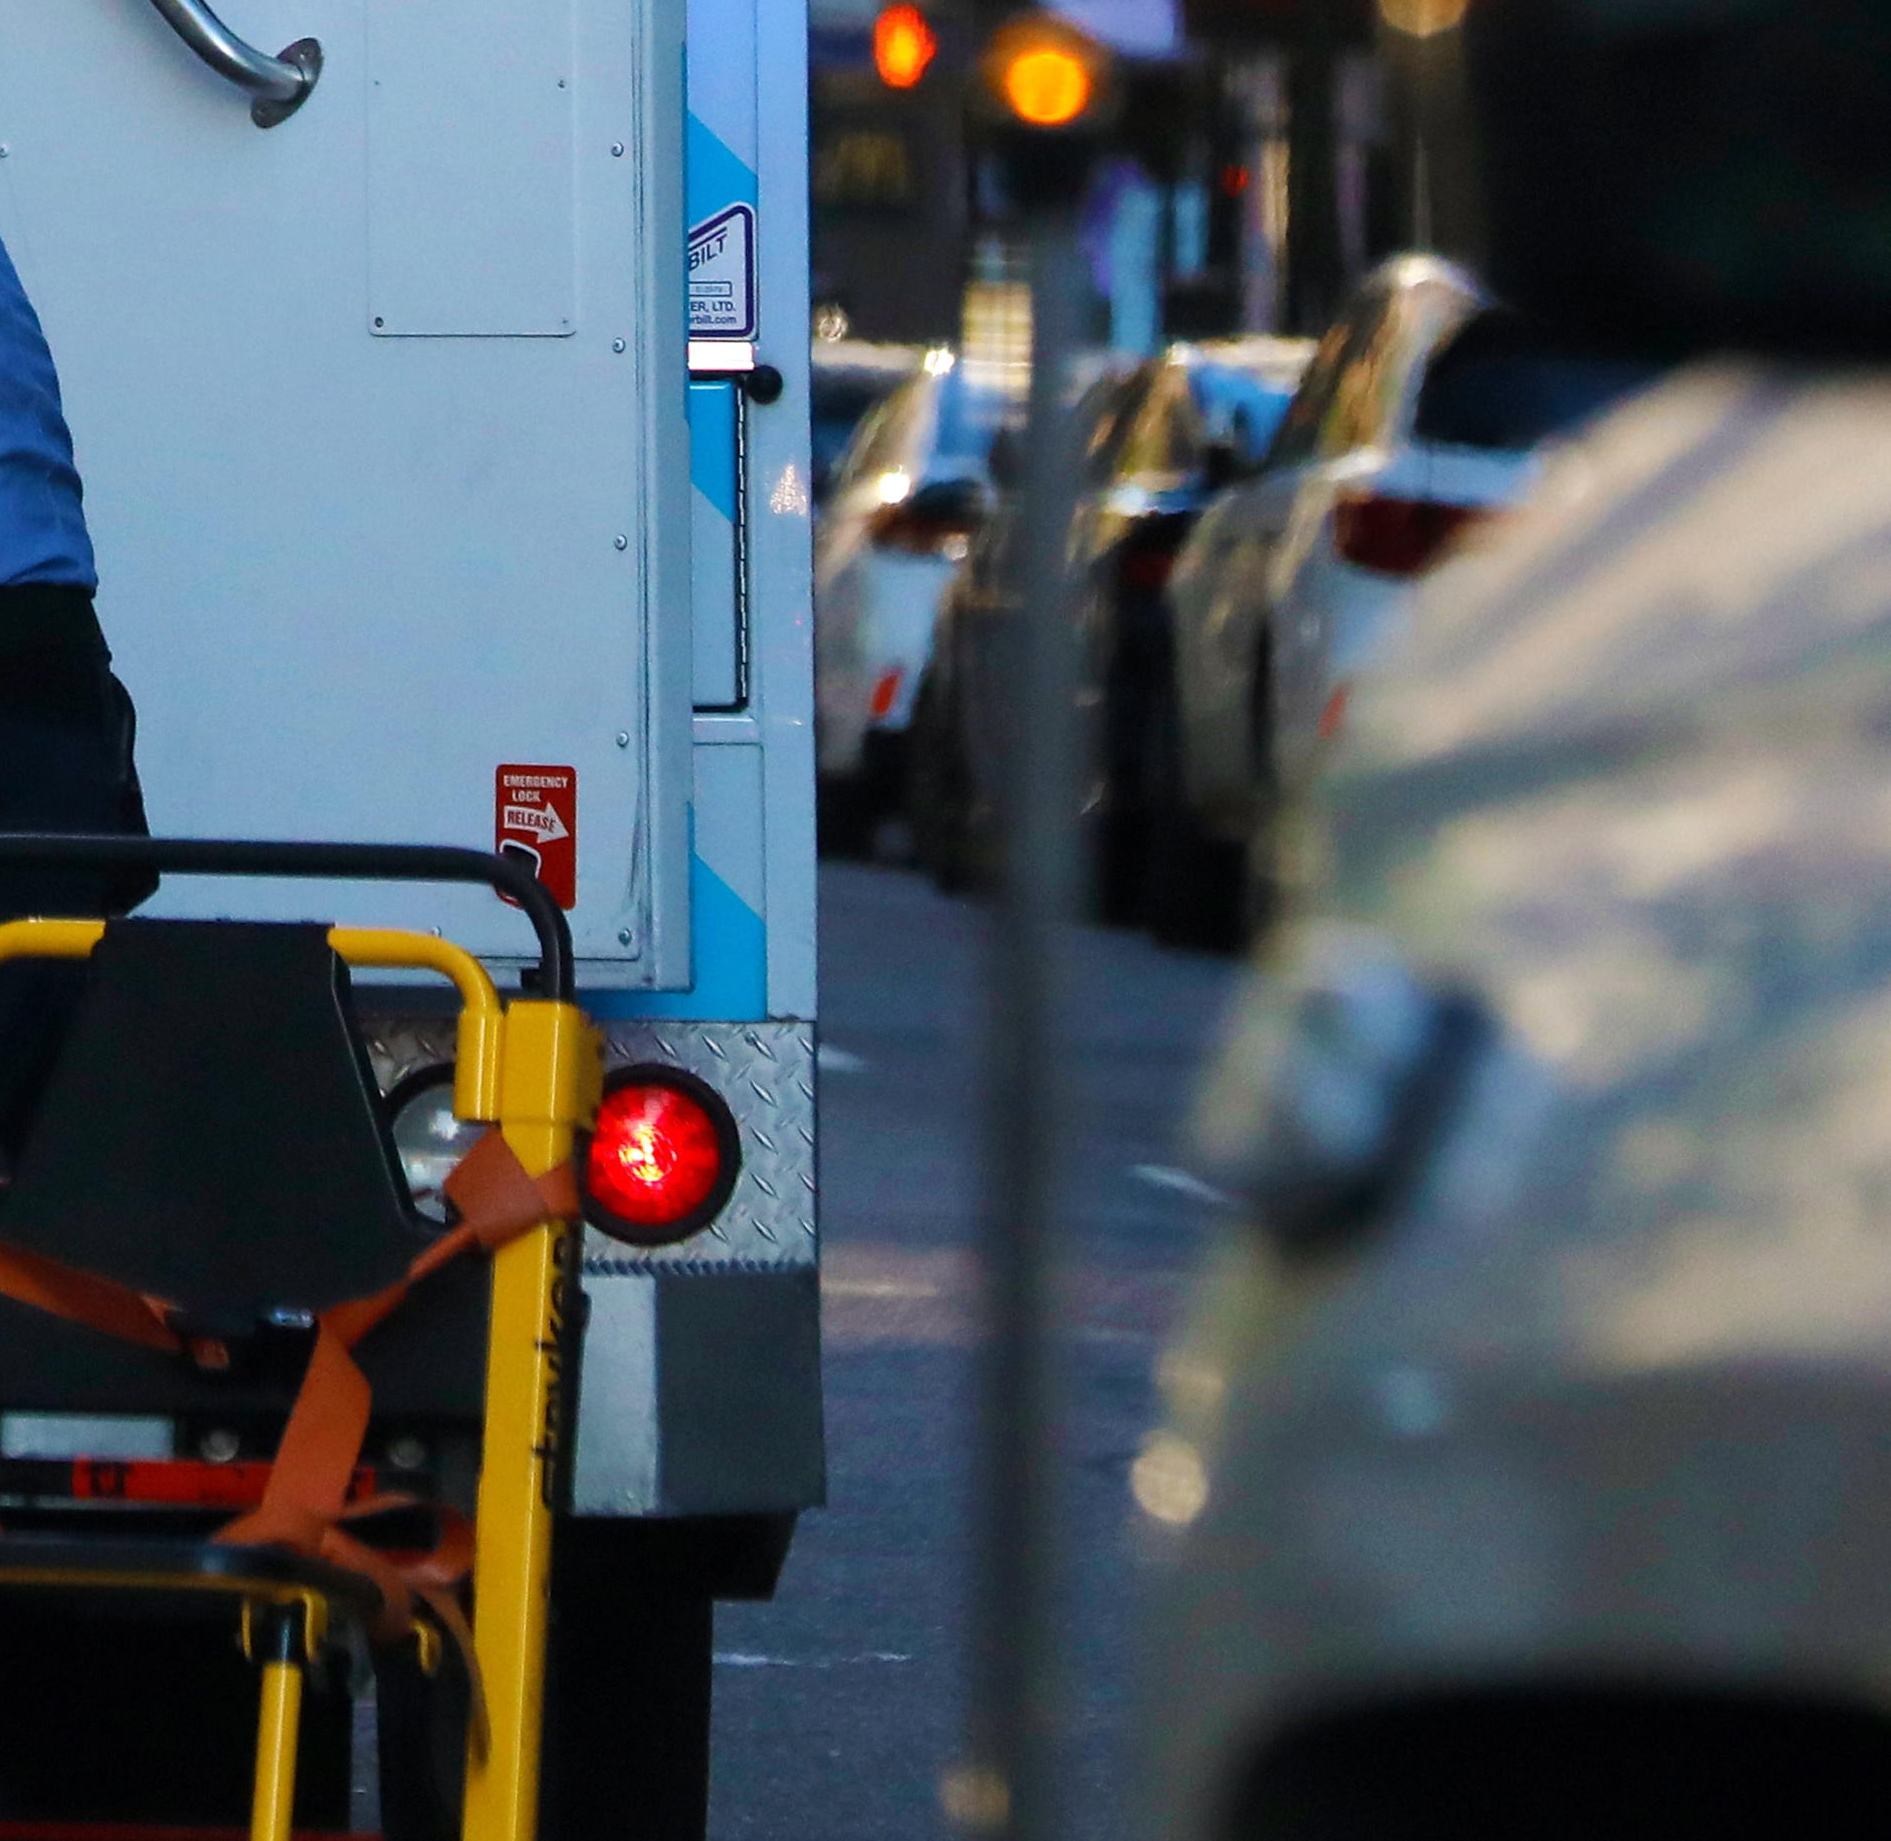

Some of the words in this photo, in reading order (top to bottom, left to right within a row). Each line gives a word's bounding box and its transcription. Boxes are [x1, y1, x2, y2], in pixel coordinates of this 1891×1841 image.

[712, 301, 736, 312] LTD.
[503, 774, 568, 789] EMERGENCY
[512, 789, 541, 802] LOCK
[507, 809, 556, 833] RELEASE
